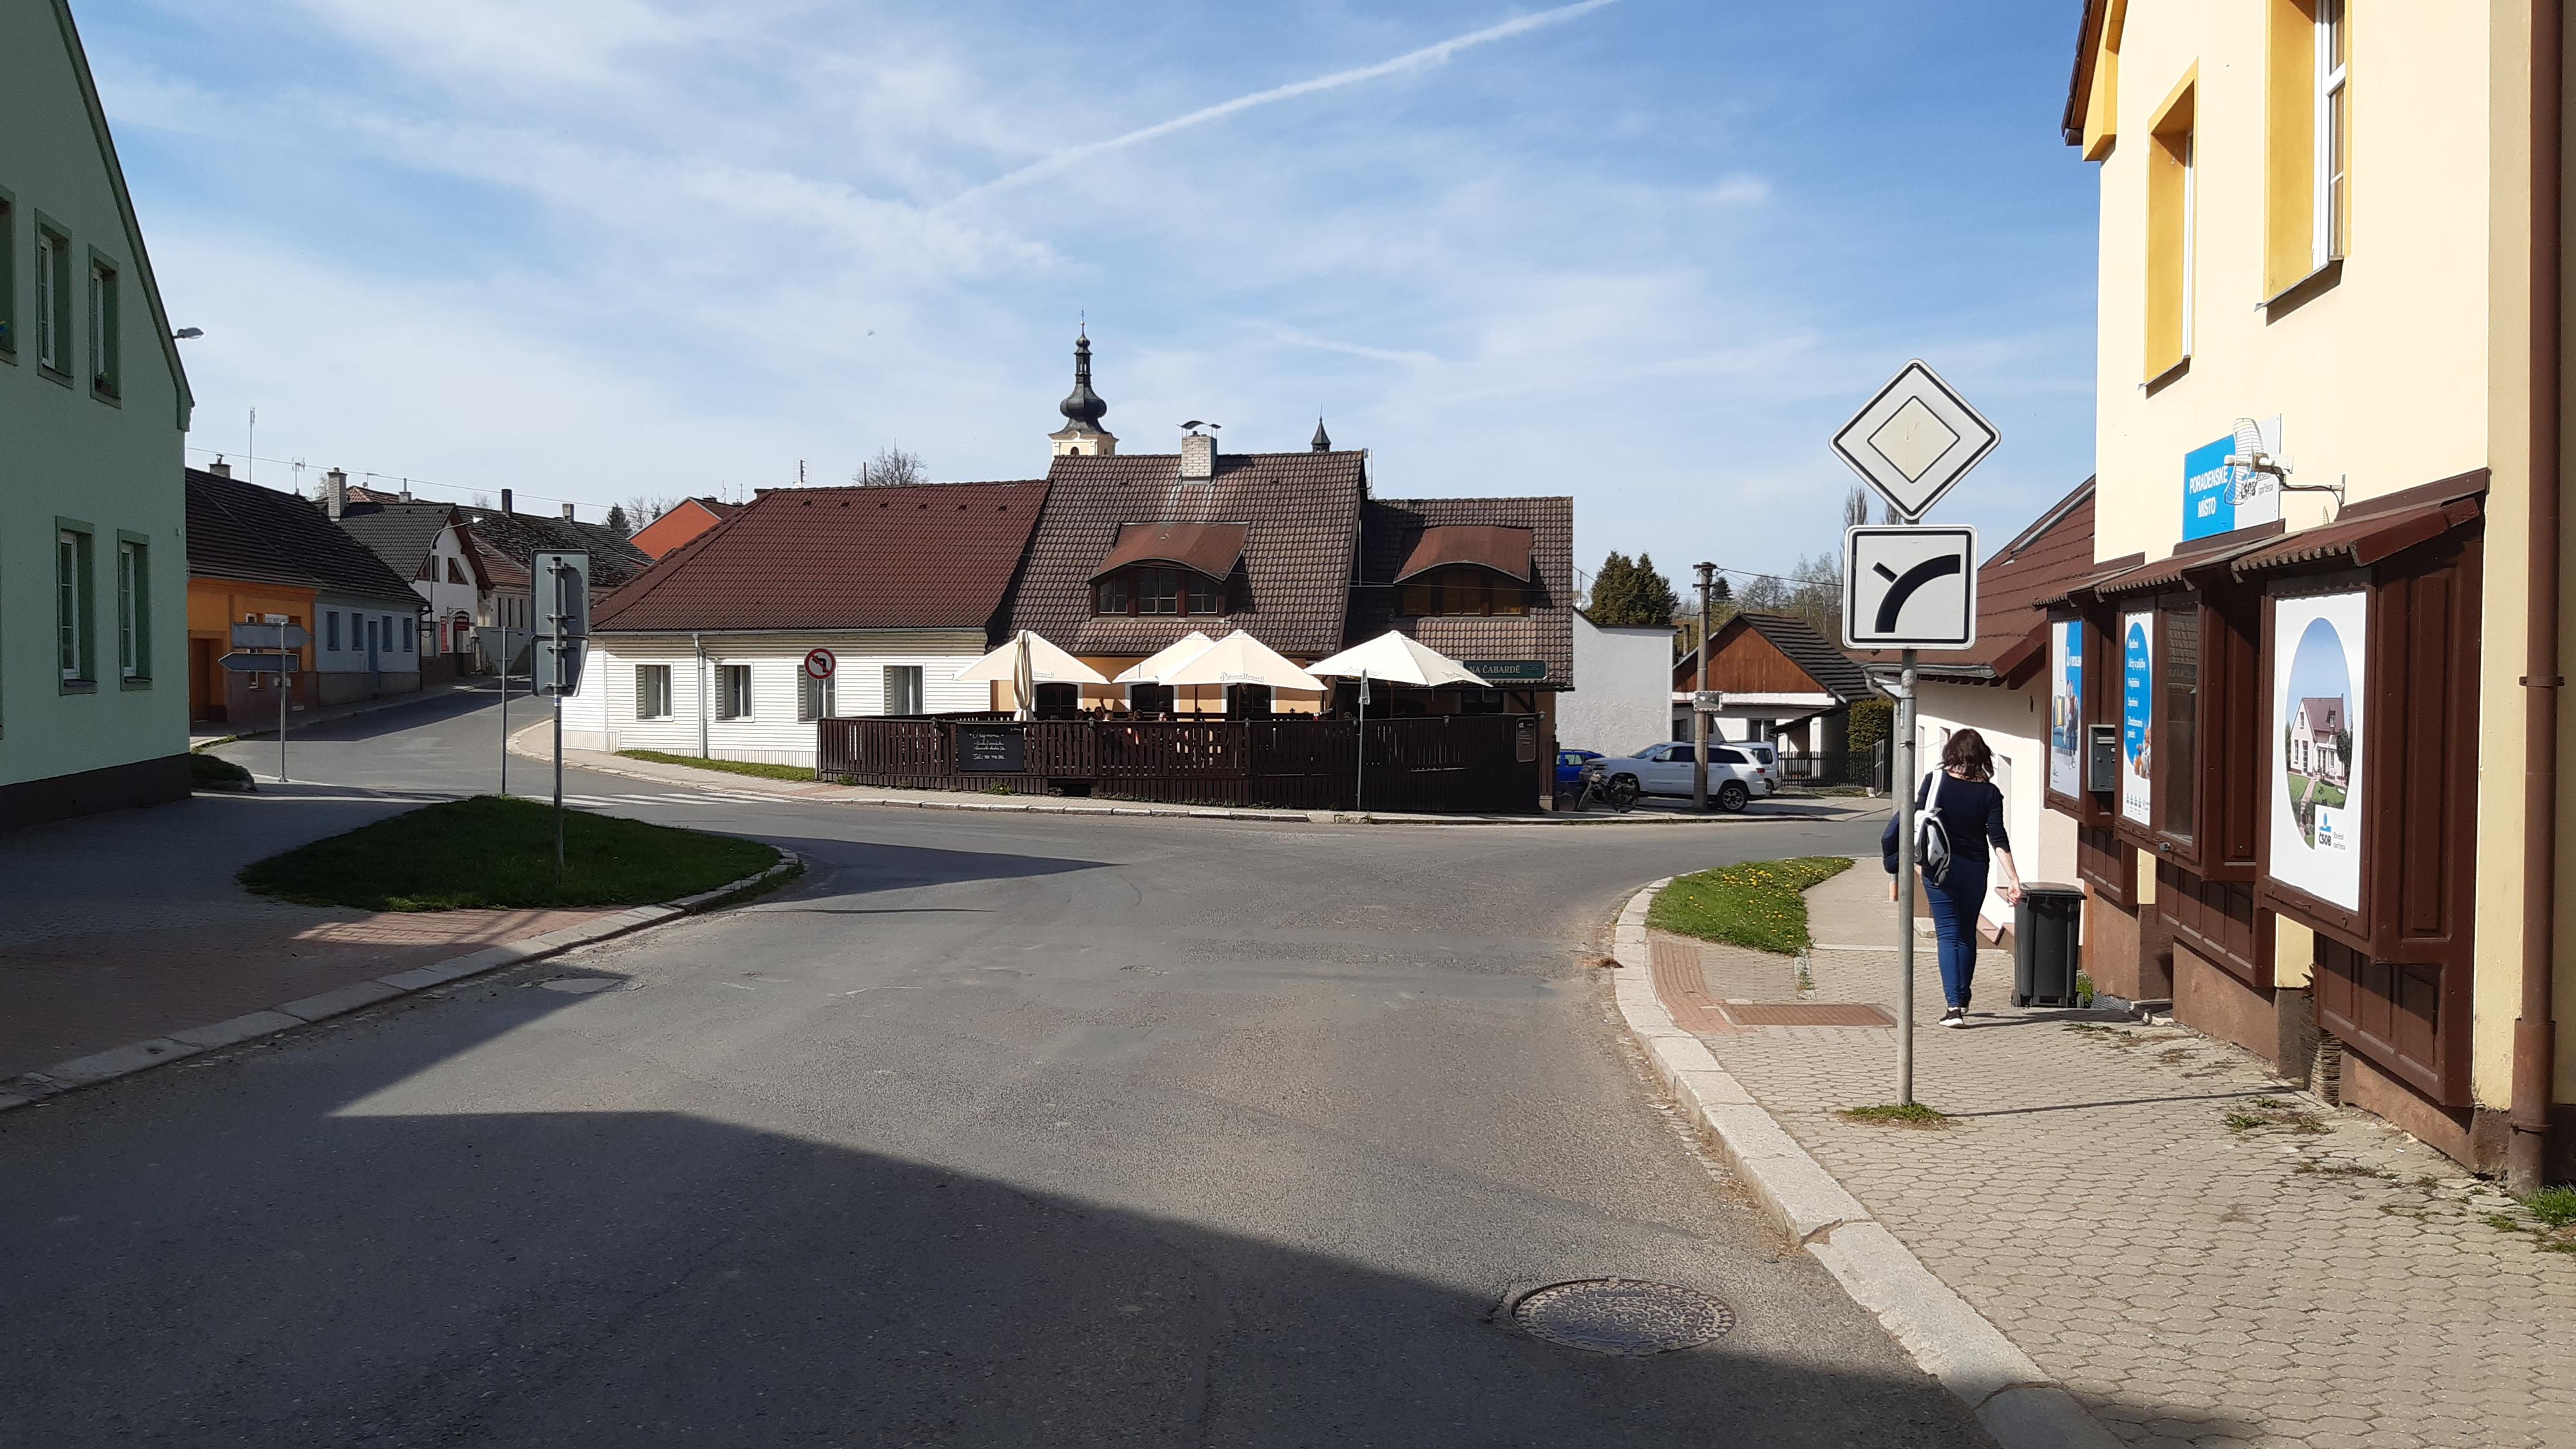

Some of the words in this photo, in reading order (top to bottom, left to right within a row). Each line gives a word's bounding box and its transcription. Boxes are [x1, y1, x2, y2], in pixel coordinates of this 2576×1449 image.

[2198, 495, 2216, 518] MÍSTO
[1482, 664, 1520, 674] ČABARDĚ
[2318, 831, 2331, 847] ČSOB
